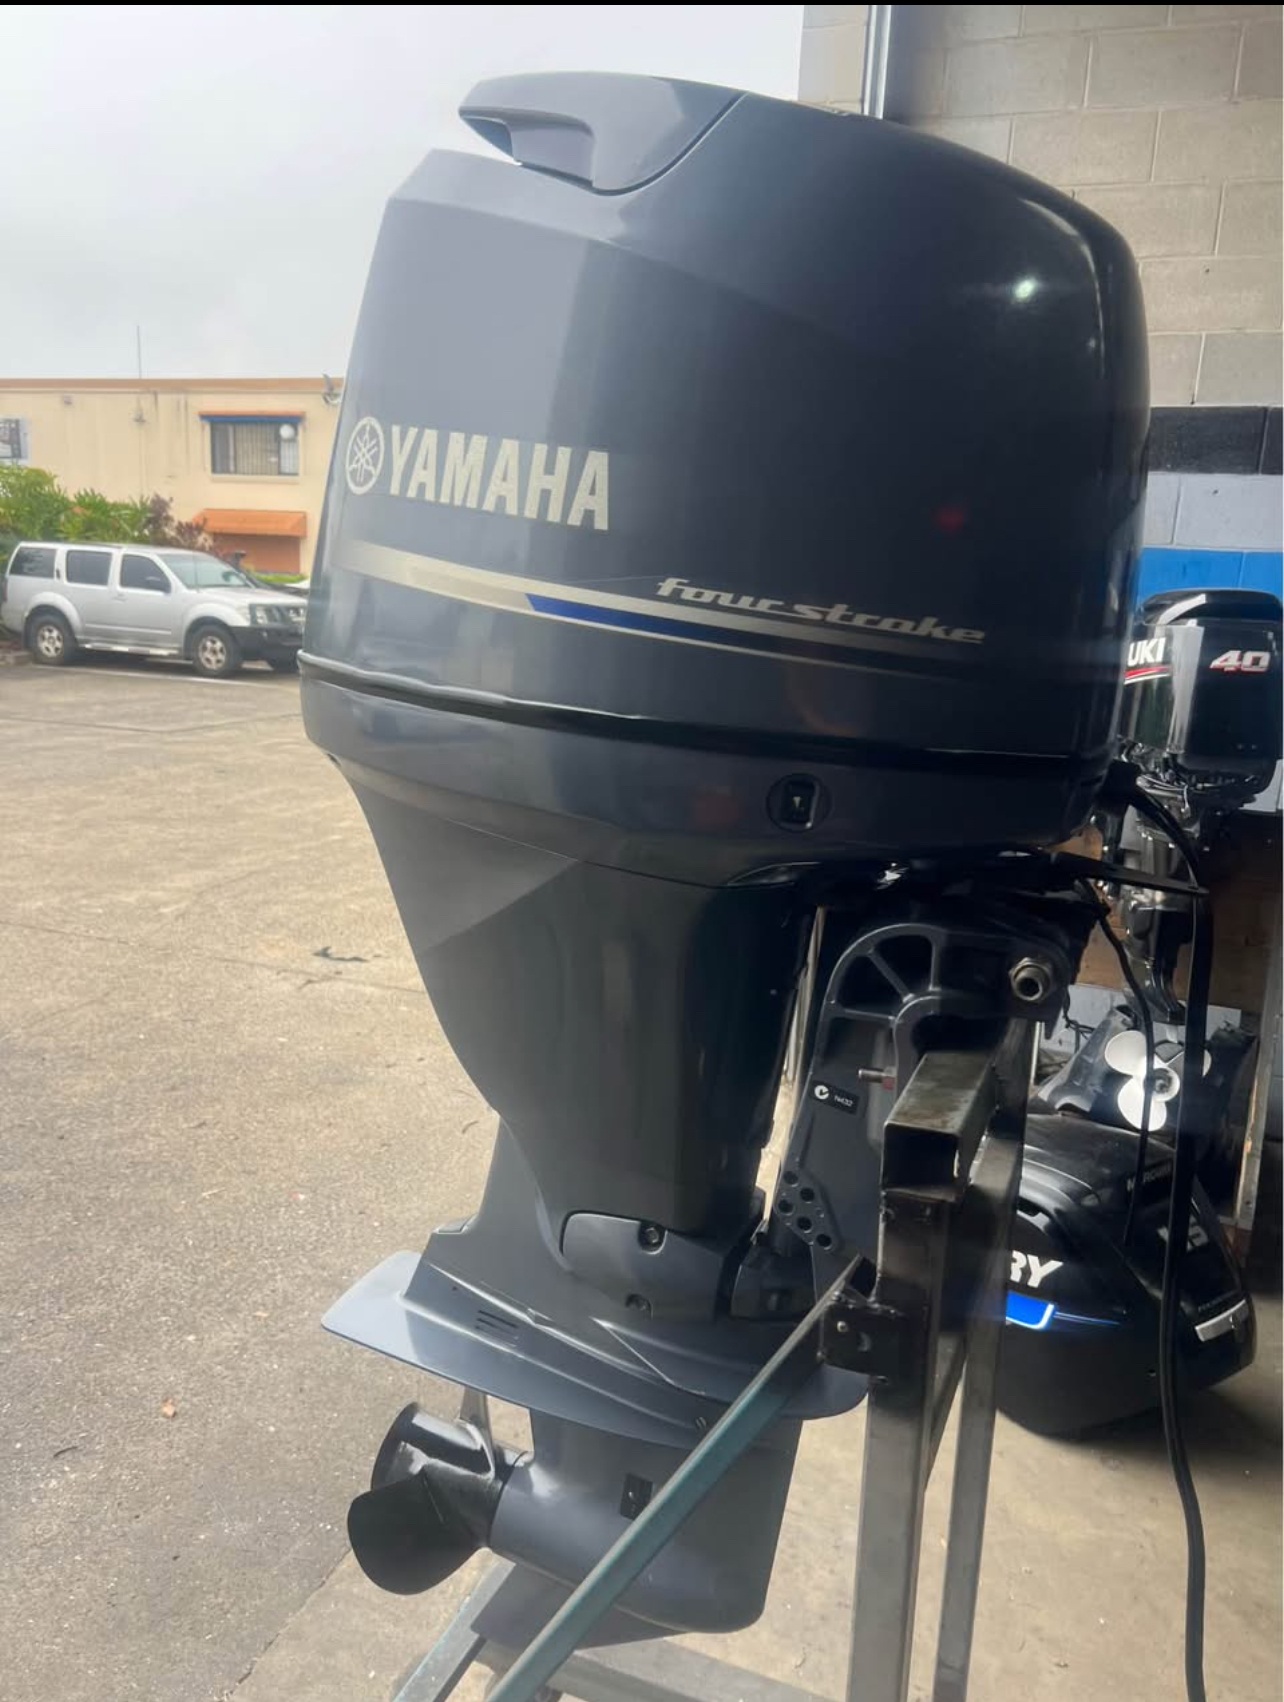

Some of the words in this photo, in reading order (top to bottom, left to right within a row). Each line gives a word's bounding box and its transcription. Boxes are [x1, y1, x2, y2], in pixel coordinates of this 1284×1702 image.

[389, 424, 610, 531] YAMAHA
[1127, 636, 1167, 667] UKI
[1209, 650, 1272, 673] 40
